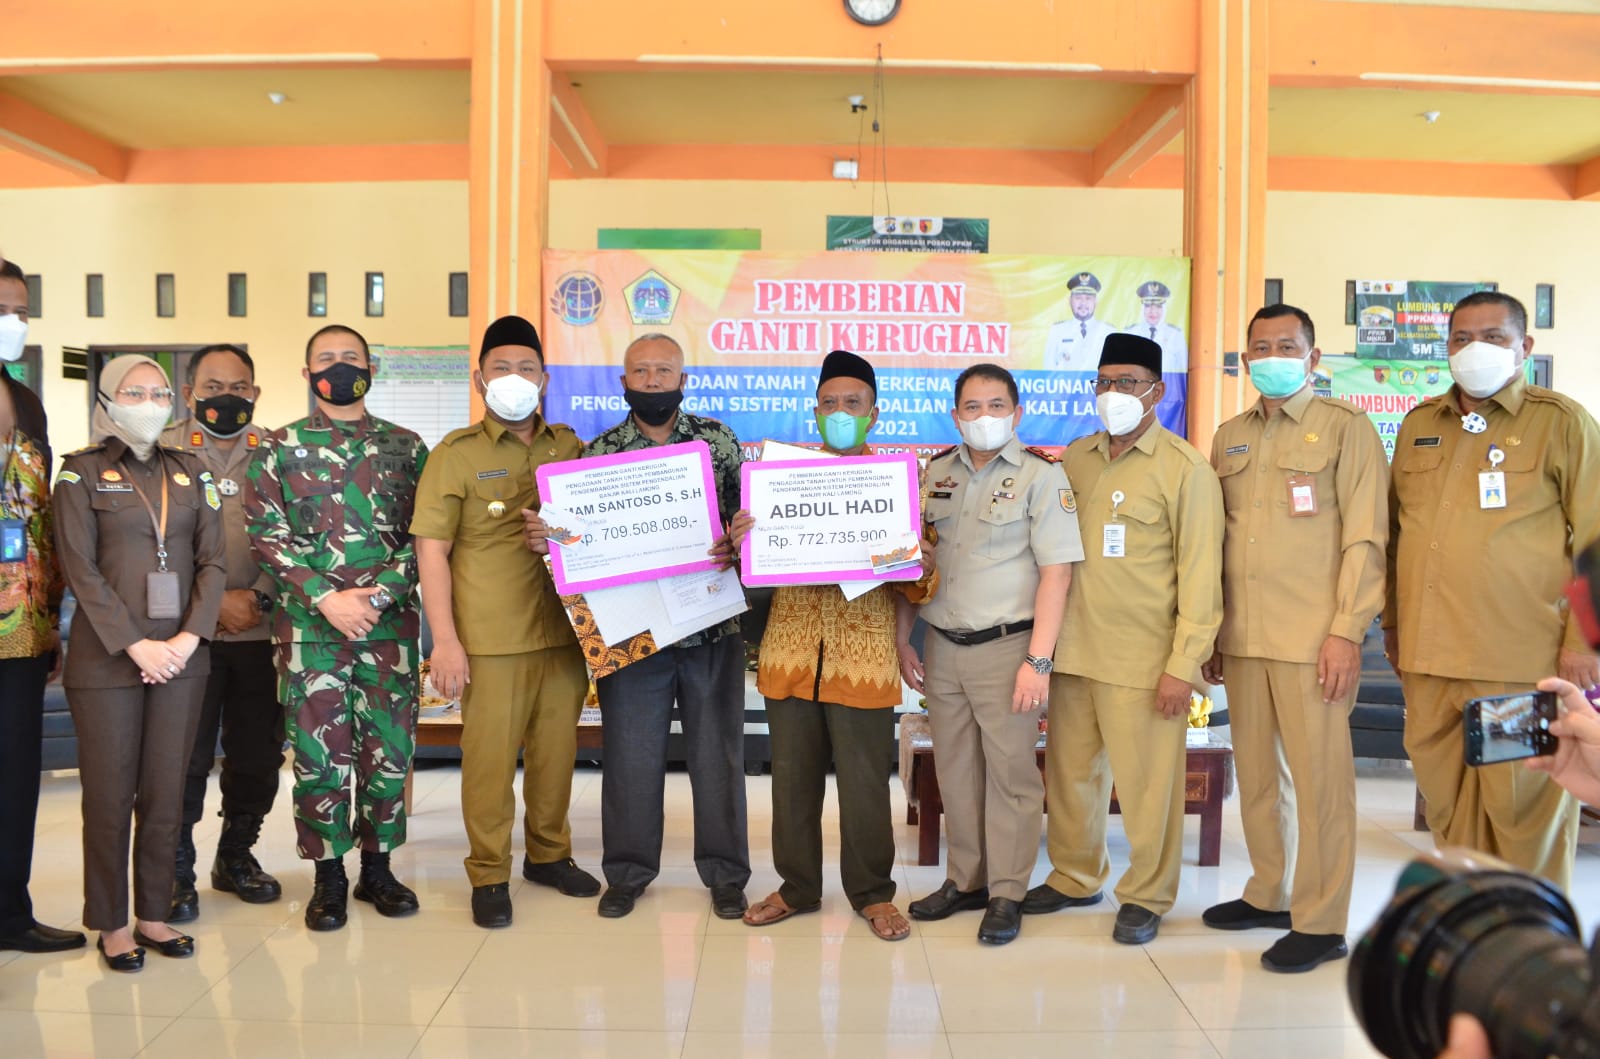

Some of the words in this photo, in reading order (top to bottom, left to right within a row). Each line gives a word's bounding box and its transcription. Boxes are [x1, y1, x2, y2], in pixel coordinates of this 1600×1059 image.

[757, 281, 963, 314] PEMBERIAN
[1397, 302, 1441, 312] LUMBUNG
[1443, 302, 1456, 313] PA
[711, 321, 819, 351] GANTI
[830, 322, 1007, 354] KERUGIAN
[1412, 344, 1432, 355] 5M
[683, 374, 738, 390] DAAN
[743, 374, 806, 391] TANAH
[728, 396, 797, 412] SISTEM
[1025, 400, 1068, 416] KALI
[874, 420, 919, 436] 2021
[565, 479, 602, 489] PENGADAAN
[603, 476, 622, 484] TANAH
[623, 473, 643, 481] UNTUK
[644, 466, 688, 478] PEMBANGUNAN
[584, 469, 619, 479] PEMBERIAN
[620, 466, 636, 474] GANTI
[637, 462, 667, 471] KERUGIAN
[570, 484, 619, 496] PENGEMBANGAN
[620, 480, 641, 489] SISTEM
[642, 474, 686, 485] PENGENDALIAN
[633, 485, 661, 494] LAMONG
[772, 485, 821, 493] PENGEMBANGAN
[598, 494, 661, 513] SANTOSO
[681, 487, 702, 500] S.H
[770, 501, 839, 519] ABDUL
[846, 498, 894, 515] HADI
[768, 535, 792, 549] Rp.
[798, 529, 888, 546] 772.735.900
